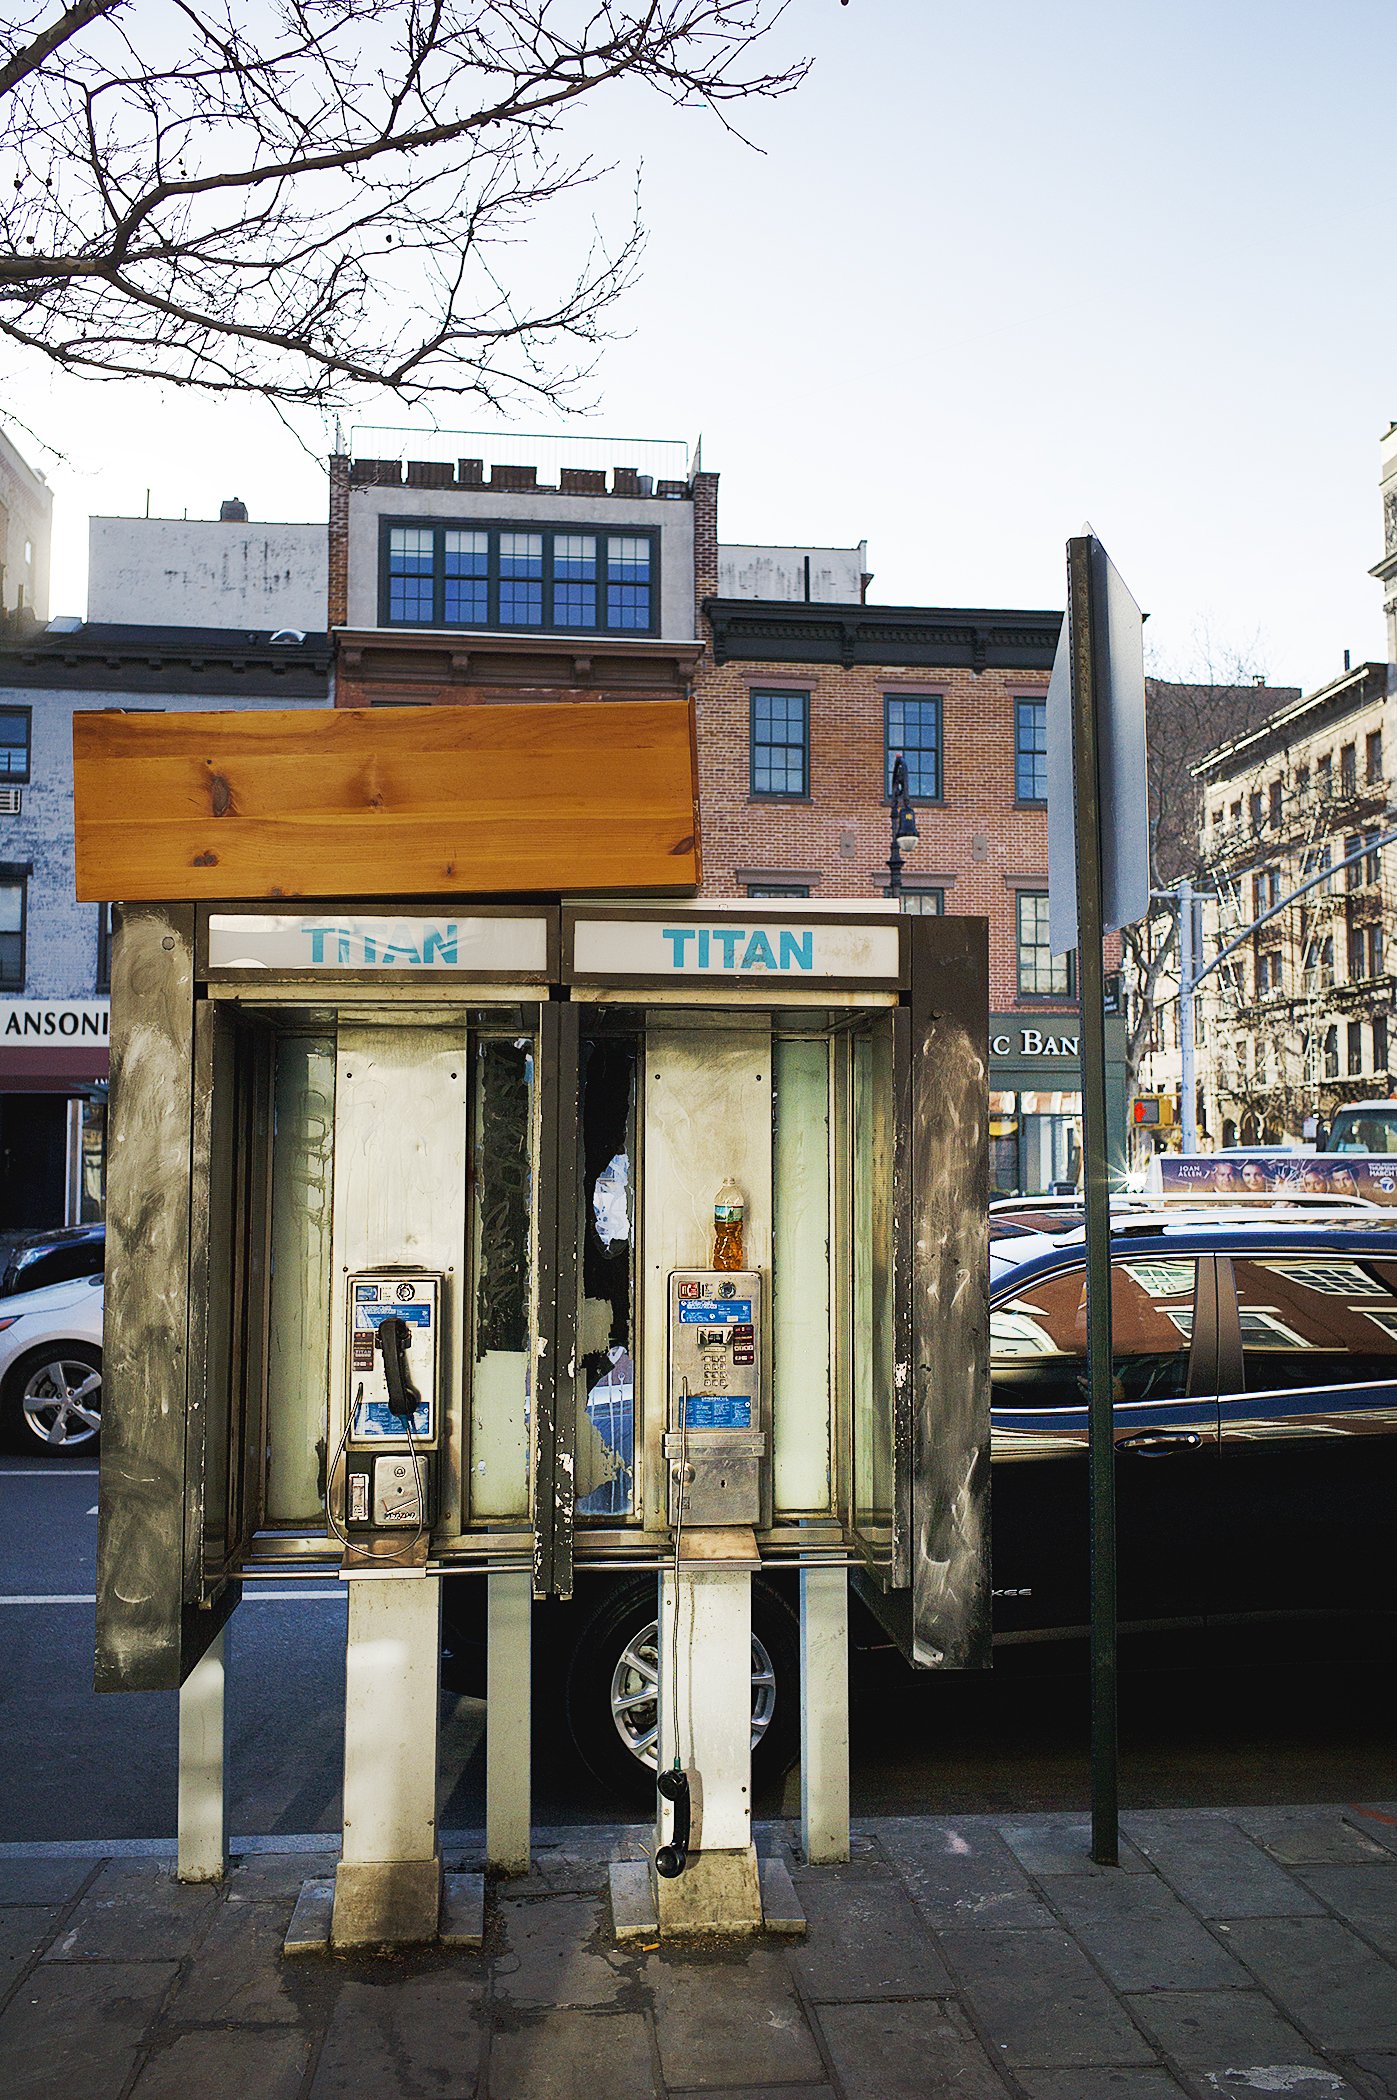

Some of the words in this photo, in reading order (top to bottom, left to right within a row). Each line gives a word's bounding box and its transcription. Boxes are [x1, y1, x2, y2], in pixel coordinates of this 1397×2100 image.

[301, 922, 458, 964] TITAN
[662, 929, 813, 970] TITAN
[5, 1012, 108, 1035] ANSONI
[989, 1035, 1010, 1055] C
